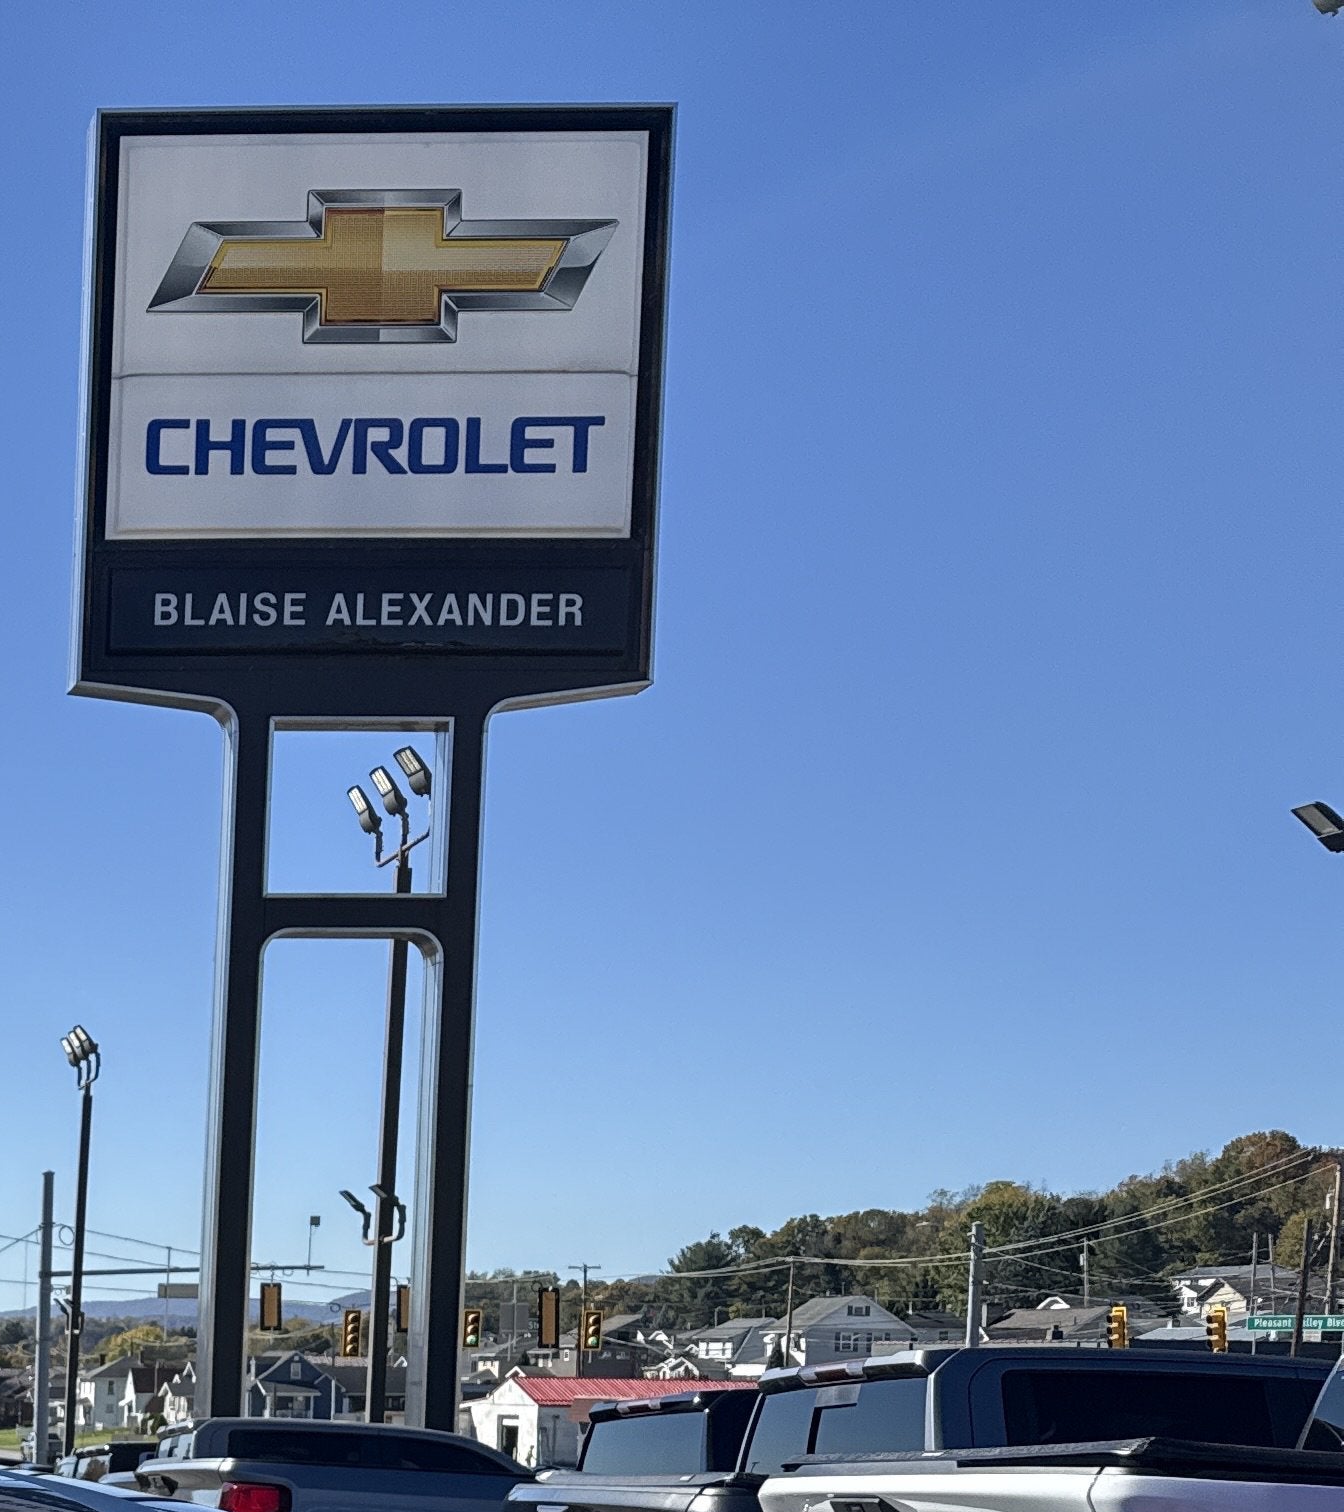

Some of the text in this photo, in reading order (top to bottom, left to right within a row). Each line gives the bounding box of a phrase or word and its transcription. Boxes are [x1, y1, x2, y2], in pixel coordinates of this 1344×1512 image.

[146, 416, 605, 475] CHEVROLET
[154, 593, 584, 627] BLAISE ALEXANDER
[1254, 1318, 1292, 1327] Pleasant
